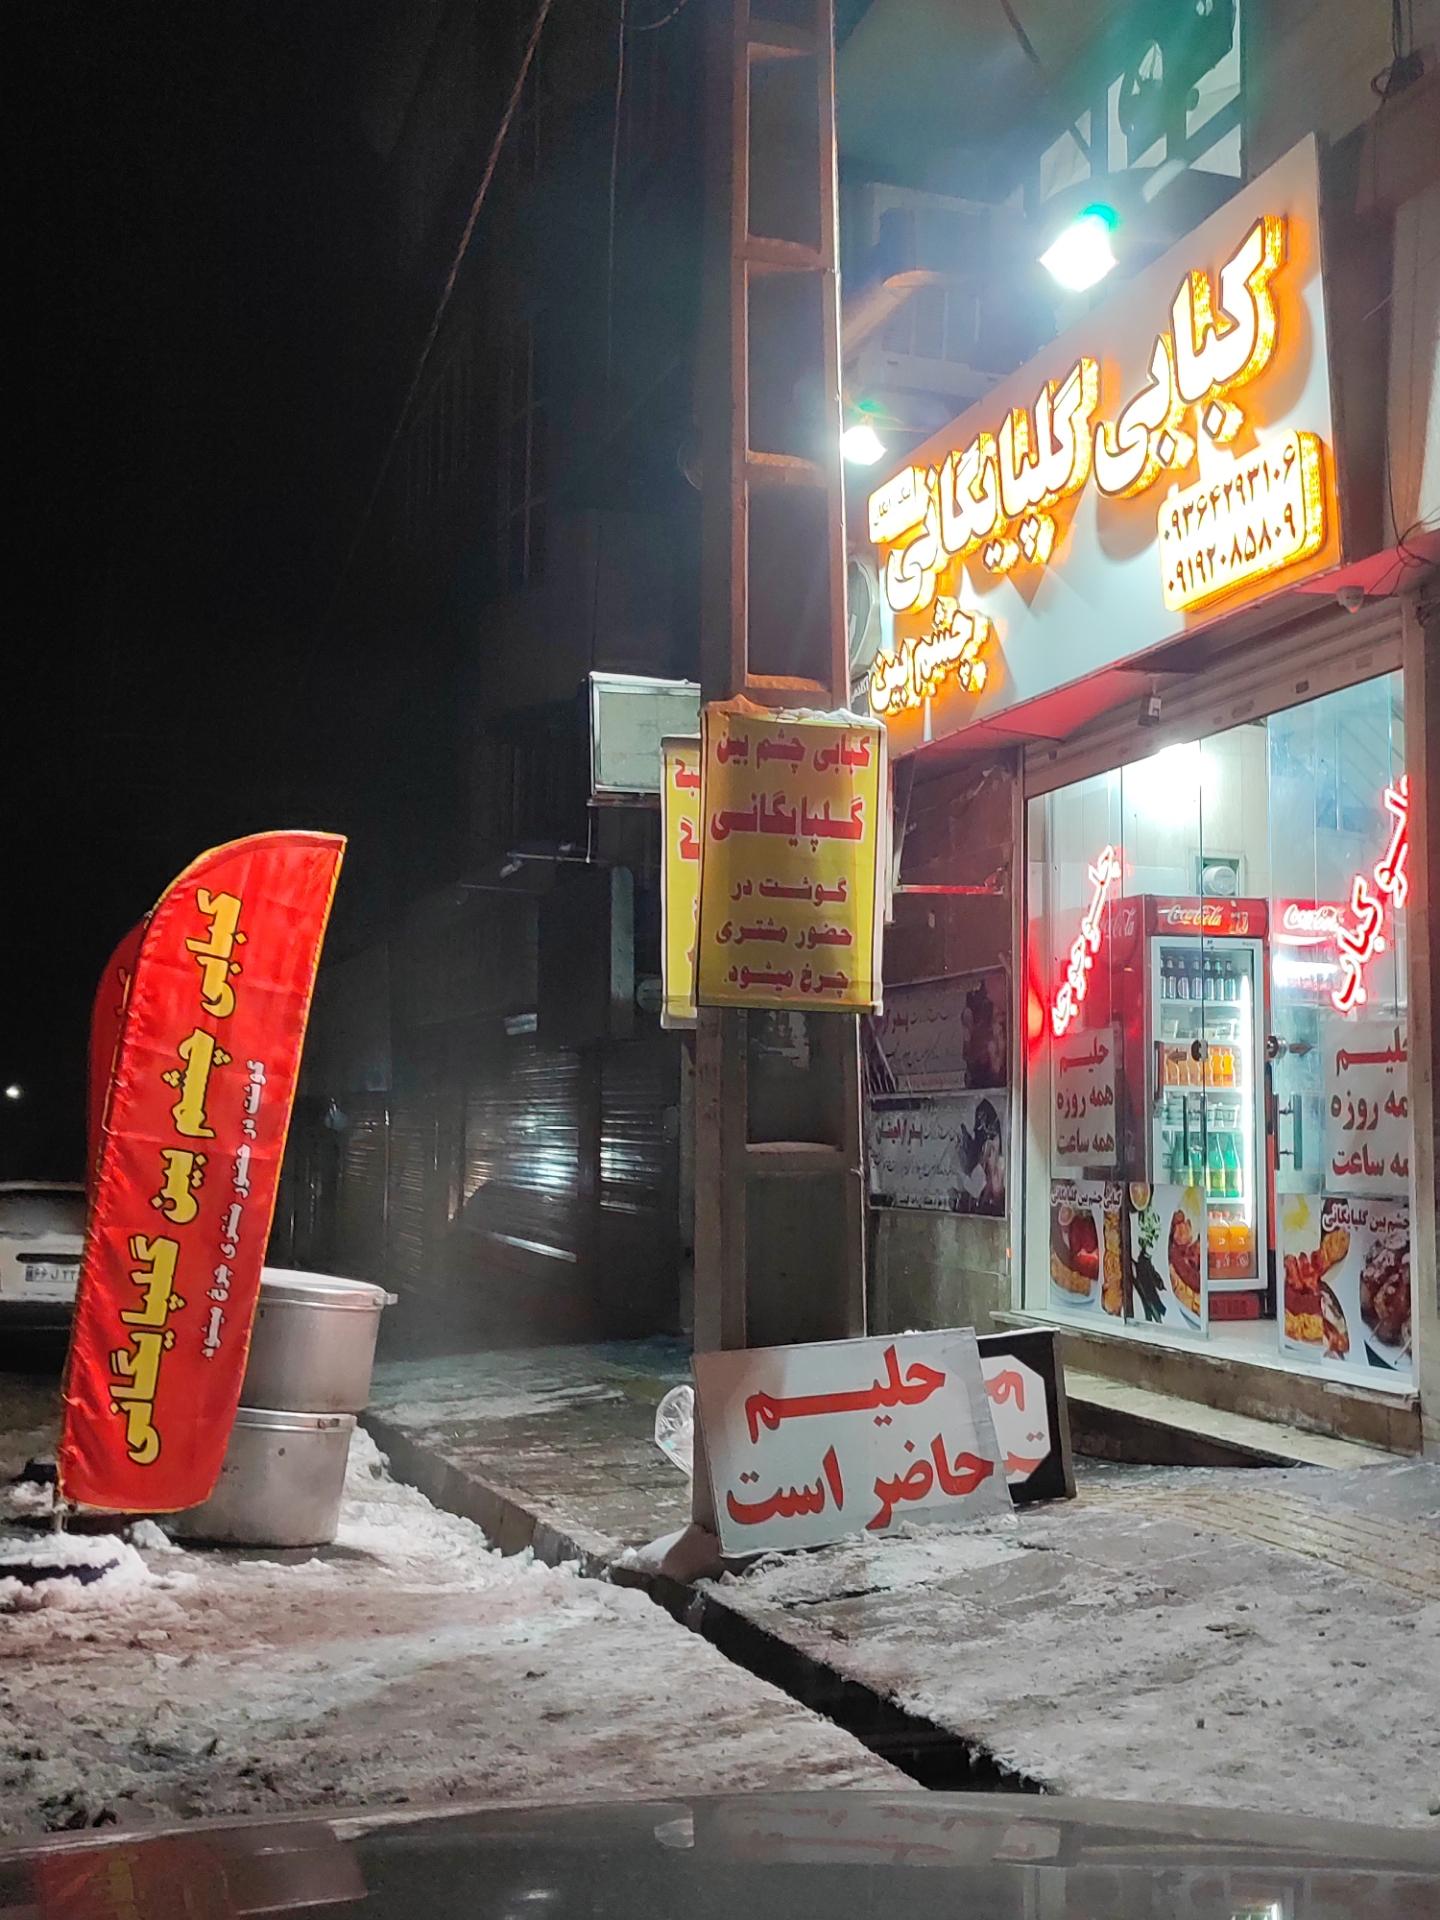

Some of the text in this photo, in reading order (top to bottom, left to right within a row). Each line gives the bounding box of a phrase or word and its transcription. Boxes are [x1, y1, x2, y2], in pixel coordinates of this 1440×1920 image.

[885, 216, 1280, 613] کبابی گلپایگانی
[1164, 444, 1296, 541] ۰۹۳۶۴۲۹۳۱۰۶
[1168, 503, 1296, 593] ۰۹۱۹۲۰۸۵۸۰۹
[869, 596, 982, 715] چشم بین
[716, 728, 870, 774] کبابی چشم بین
[710, 790, 863, 853] گلپایگانی
[730, 876, 847, 907] گوشت در
[1332, 774, 1408, 1012] لو کباب
[716, 917, 853, 950] حضور مشتری
[1167, 904, 1224, 926] Coca-Cola
[800, 963, 849, 998] چرخ
[1060, 1035, 1109, 1077] حلیم
[1336, 1026, 1408, 1077] لیم
[1056, 1084, 1114, 1119] همه روزه
[1331, 1091, 1379, 1131] روزه
[242, 1118, 257, 1140] در
[1056, 1127, 1115, 1155] همه ساعت
[109, 888, 248, 1466] کبابی چشم بین گلپایگانی
[232, 1143, 251, 1199] حضور
[1332, 1143, 1409, 1178] مه ساعت
[219, 1201, 244, 1260] مشتری
[1323, 1205, 1369, 1231] گلپایگانی
[1369, 1216, 1386, 1232] بین
[206, 1263, 235, 1302] چرخ
[744, 1344, 946, 1444] حلیم
[726, 1445, 844, 1525] است
[865, 1433, 995, 1531] حاضر
